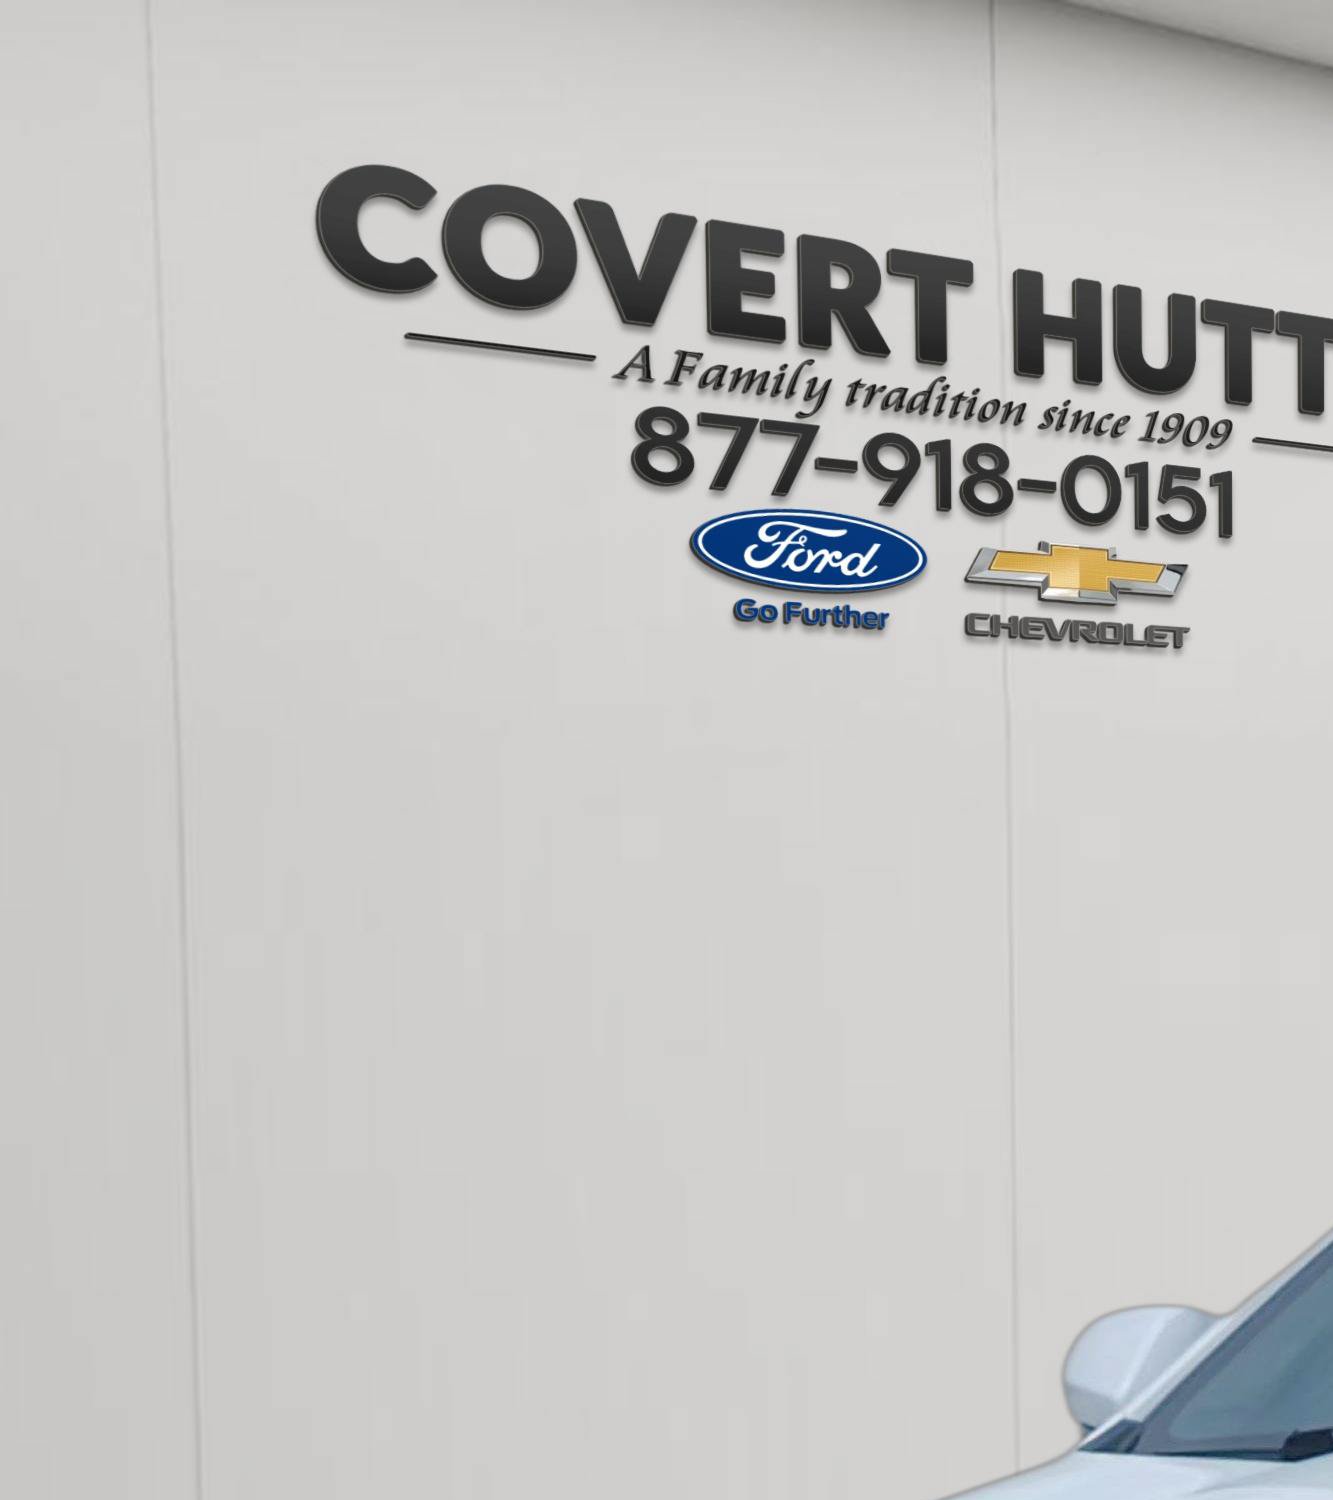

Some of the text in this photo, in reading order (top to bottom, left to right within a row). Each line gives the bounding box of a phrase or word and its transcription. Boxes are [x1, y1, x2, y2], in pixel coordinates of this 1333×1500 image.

[315, 163, 974, 366] COVERT
[612, 344, 1233, 450] A Family tradition since 1909
[630, 406, 1233, 539] 877-918-0151
[743, 520, 881, 578] Ford
[733, 598, 890, 631] Go Further
[963, 612, 1191, 650] CHEVROLET
